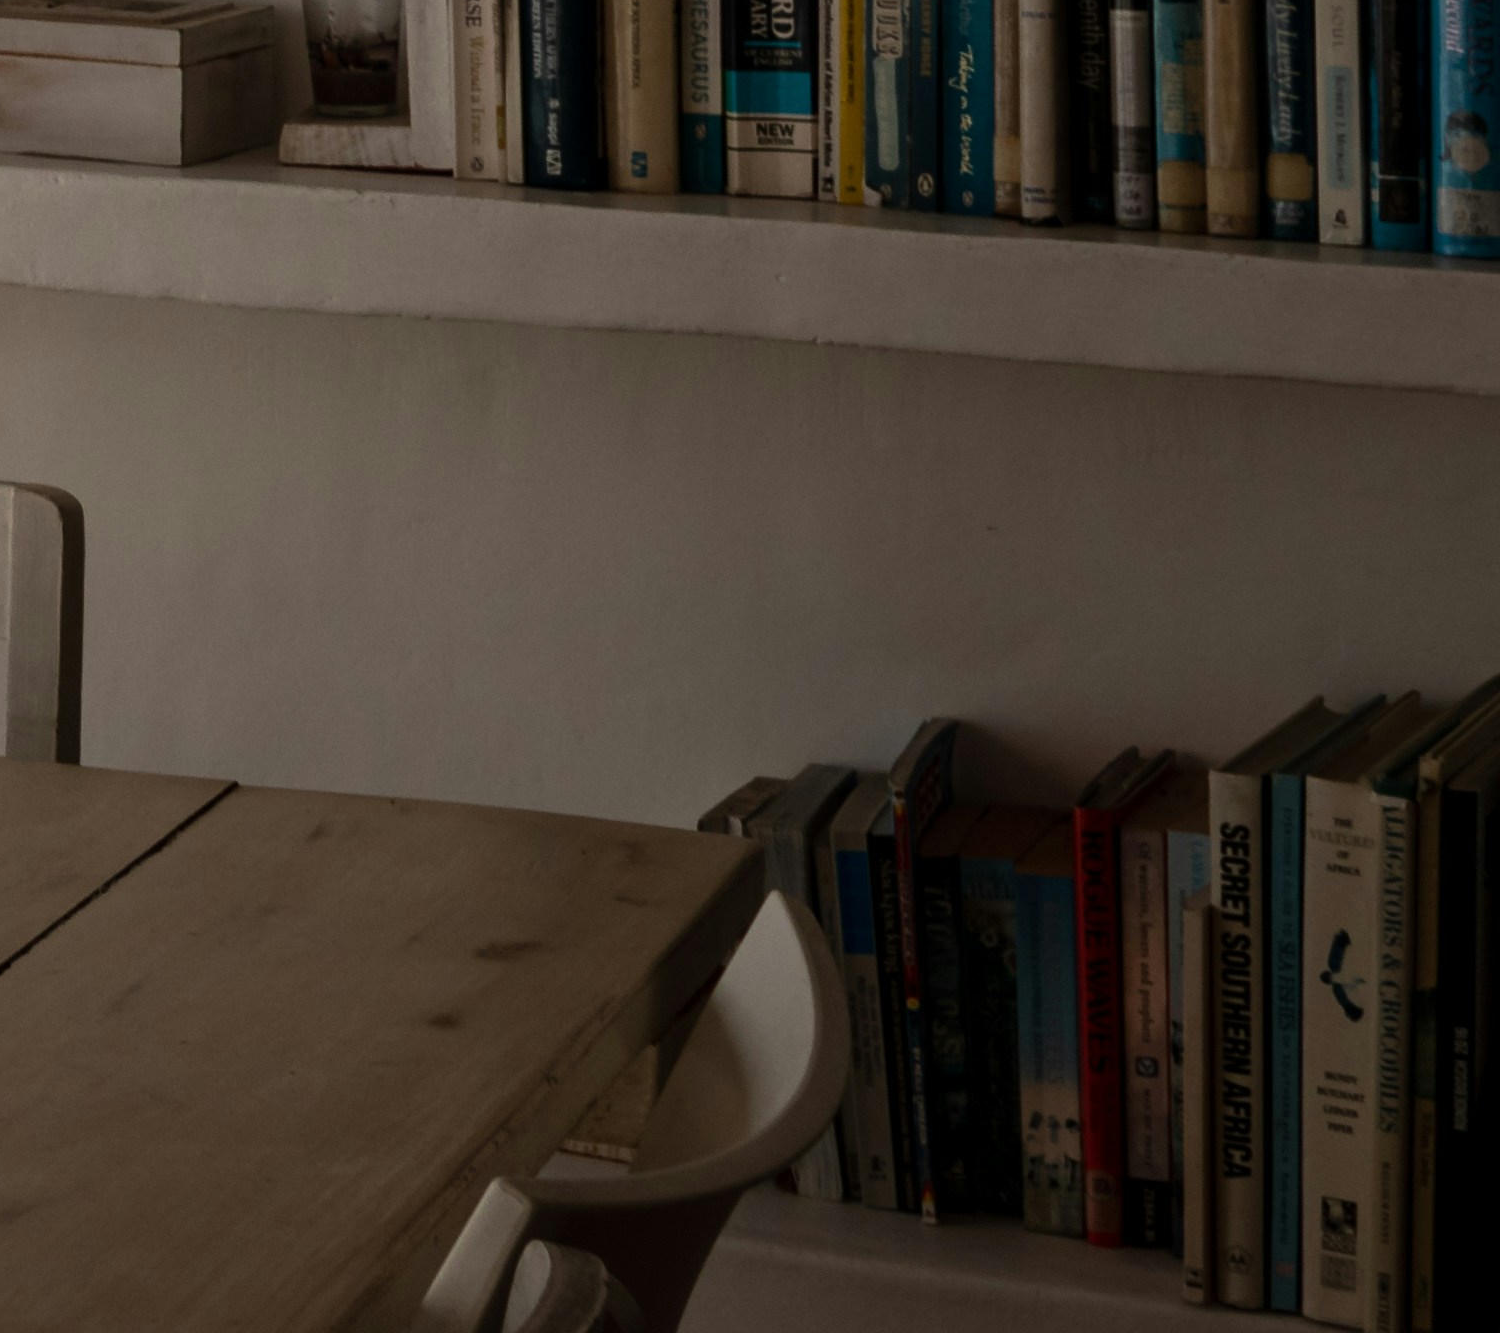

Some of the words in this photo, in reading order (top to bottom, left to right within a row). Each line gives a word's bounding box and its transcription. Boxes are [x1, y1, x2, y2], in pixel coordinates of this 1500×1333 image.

[1330, 14, 1345, 49] SOUL
[468, 36, 484, 92] Without
[948, 44, 974, 93] Taking
[1075, 51, 1105, 90] day
[470, 106, 485, 145] Trace
[755, 122, 795, 138] NEW
[1274, 91, 1301, 146] Lady
[1081, 832, 1114, 952] ROGUE
[1220, 822, 1250, 927] SECRET
[1382, 806, 1406, 948] ALLIGATORS
[1279, 941, 1295, 971] SEA
[1383, 954, 1403, 971] &
[1085, 958, 1117, 1074] WAVES
[1221, 933, 1251, 1073] SOUTHERN
[1279, 975, 1296, 1030] FISHES
[1378, 981, 1402, 1134] CROCODILES
[1222, 1080, 1253, 1179] AFRICA
